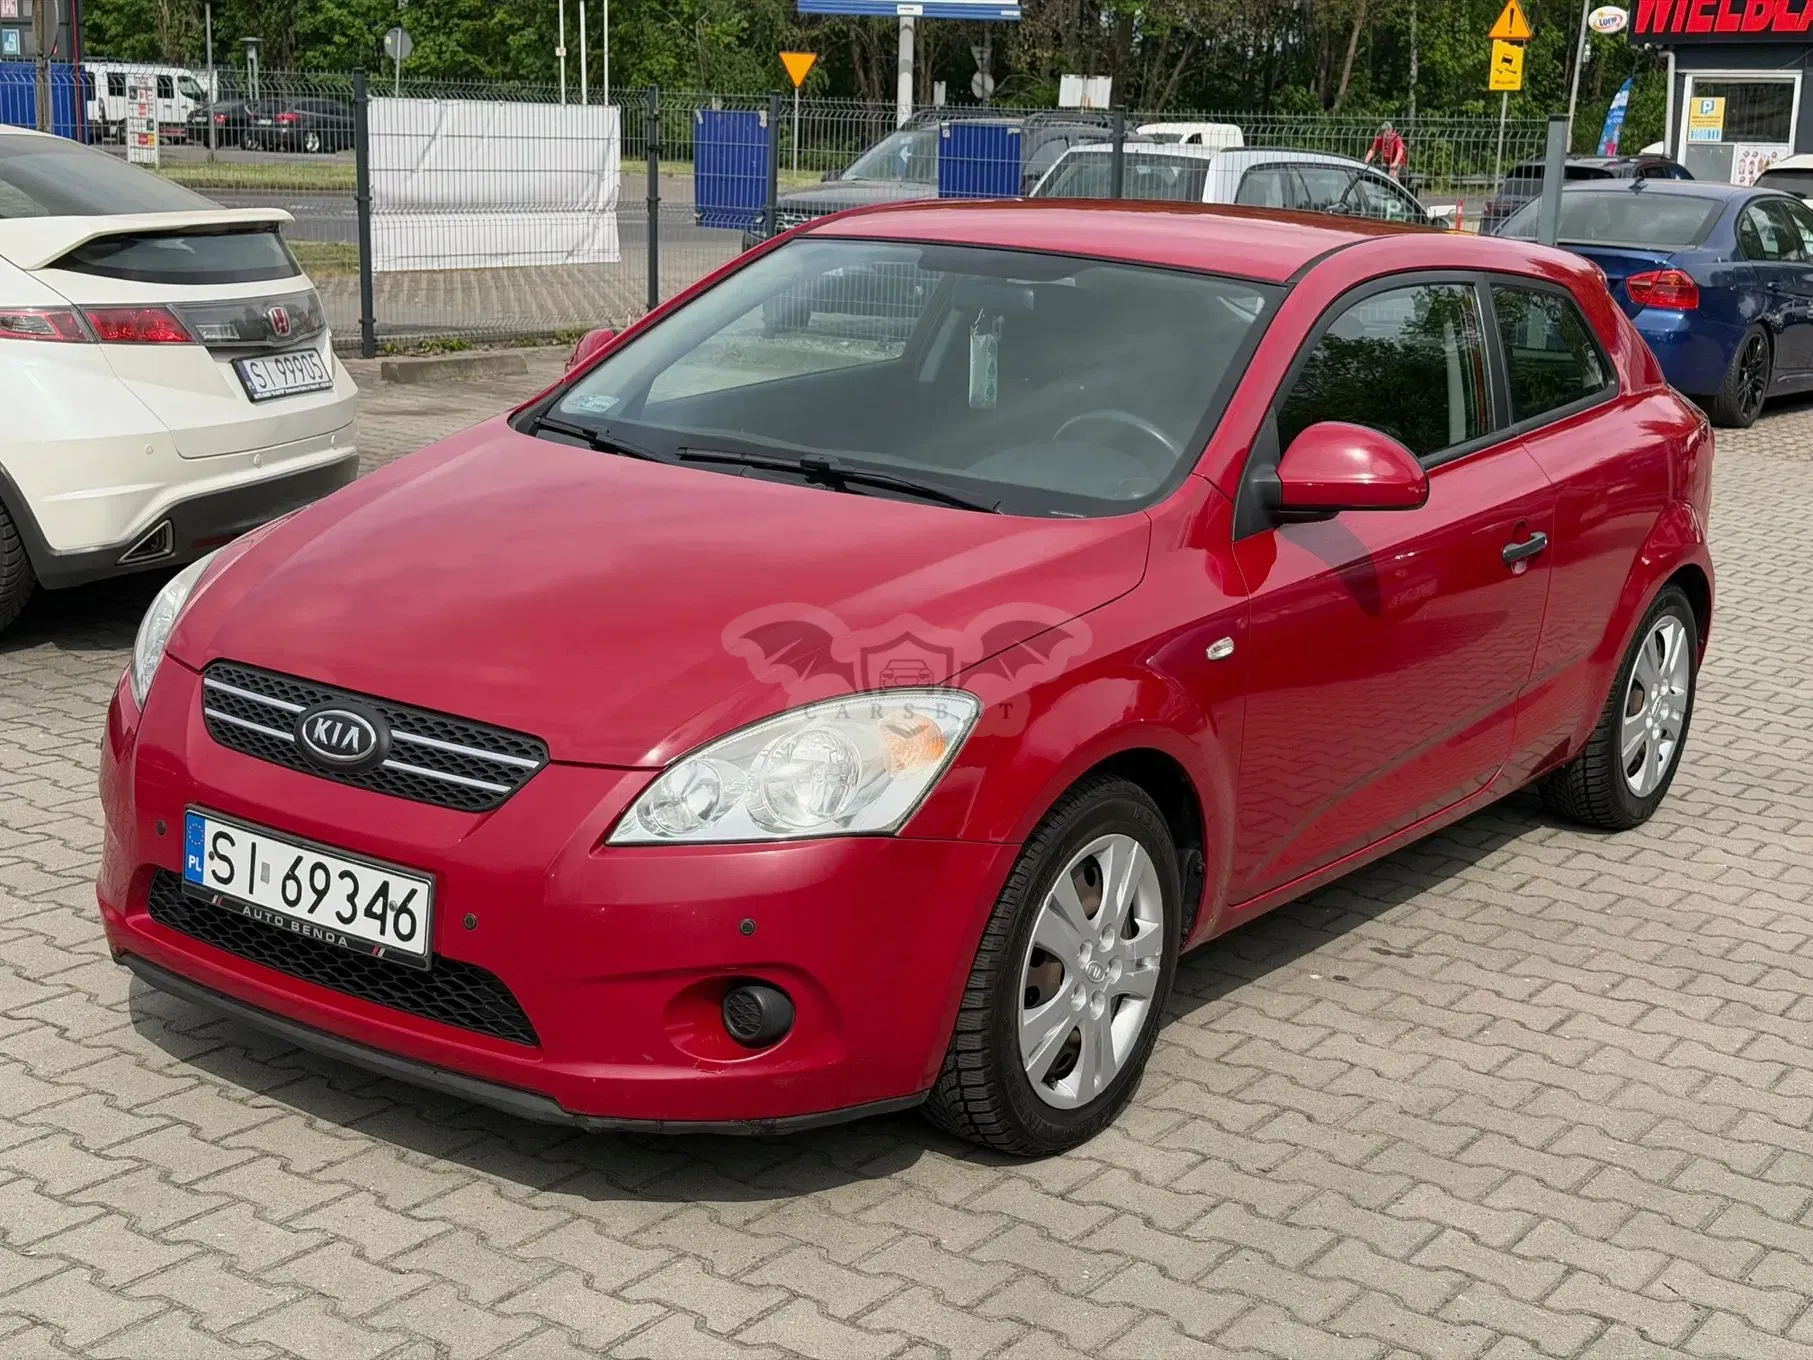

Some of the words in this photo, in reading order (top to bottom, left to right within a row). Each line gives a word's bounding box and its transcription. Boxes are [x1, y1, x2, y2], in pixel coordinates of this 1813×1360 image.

[250, 360, 275, 388] SI
[276, 354, 323, 385] 99905
[312, 717, 360, 753] KIA
[188, 854, 203, 872] PL
[210, 830, 257, 895] SI
[281, 855, 419, 943] 69346
[242, 905, 284, 927] AUTO
[291, 921, 349, 948] BENDA
